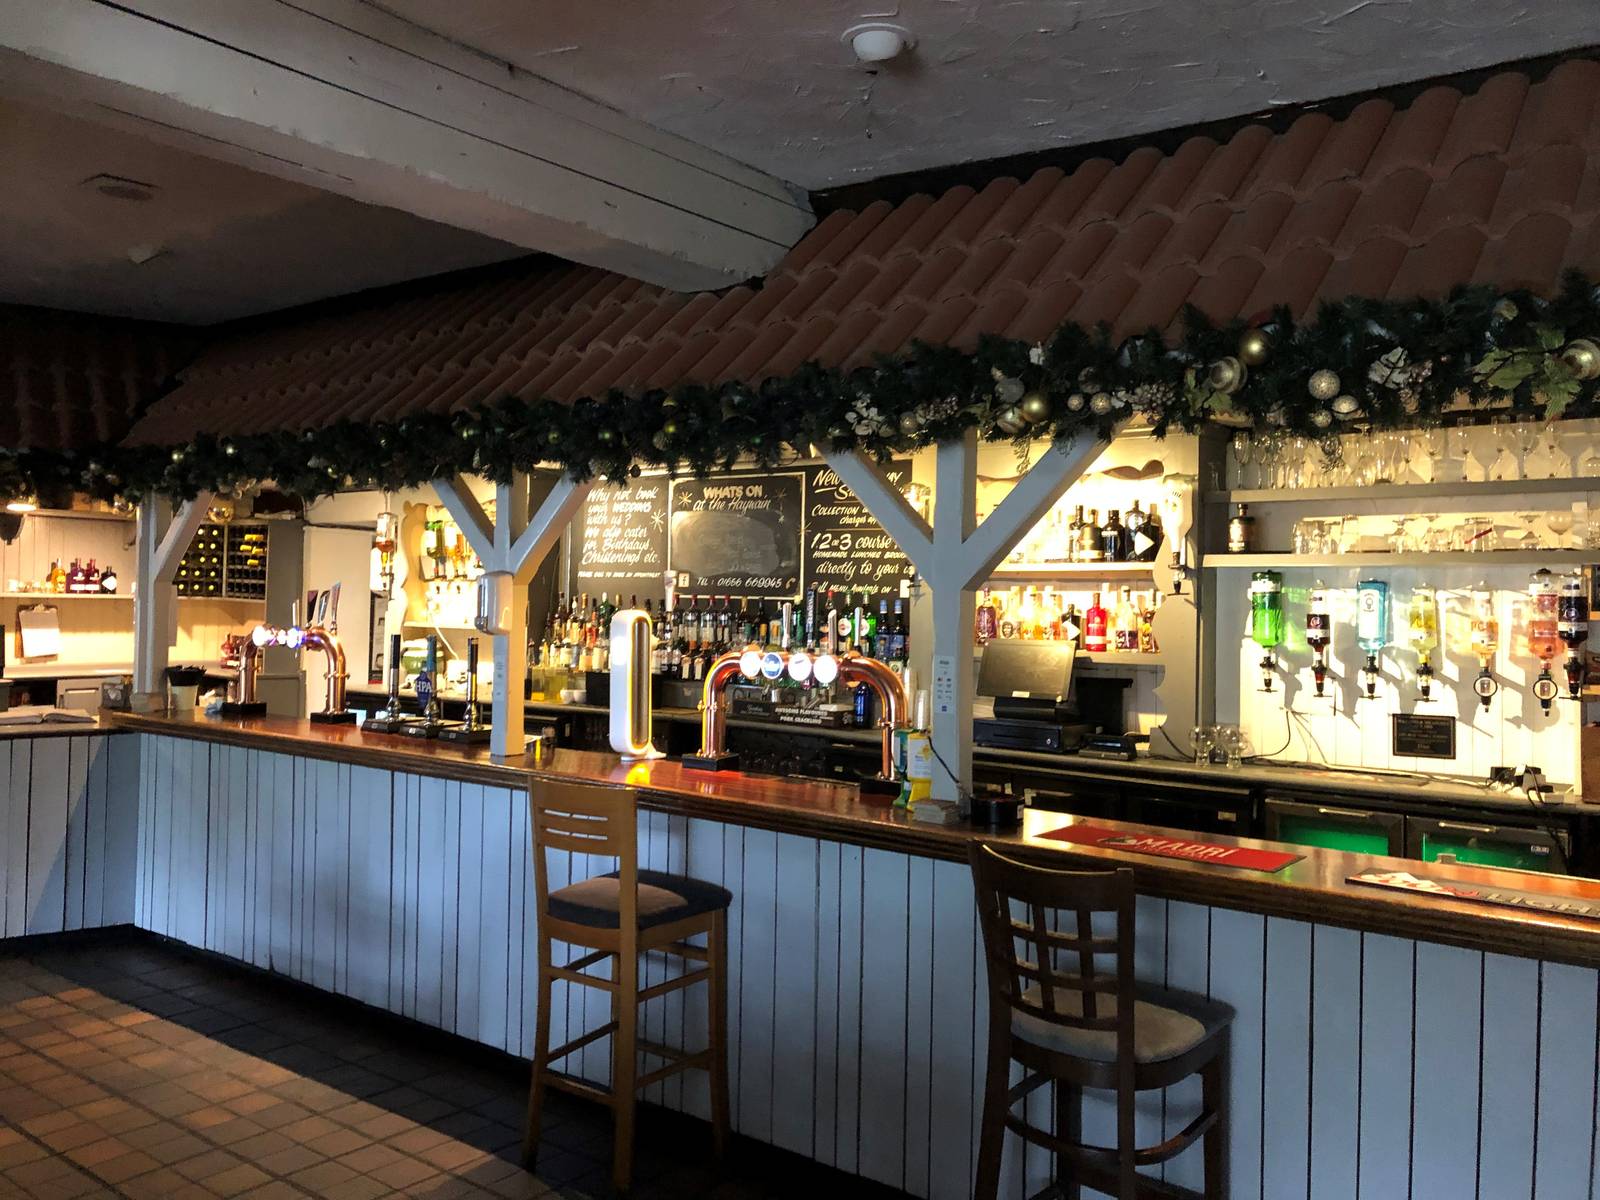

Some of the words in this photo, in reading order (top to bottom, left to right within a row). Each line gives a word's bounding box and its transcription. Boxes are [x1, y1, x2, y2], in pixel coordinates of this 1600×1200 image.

[587, 487, 611, 504] Why
[613, 487, 633, 501] not
[745, 485, 763, 497] ON
[692, 499, 707, 512] at
[708, 494, 727, 511] the
[859, 559, 873, 575] to
